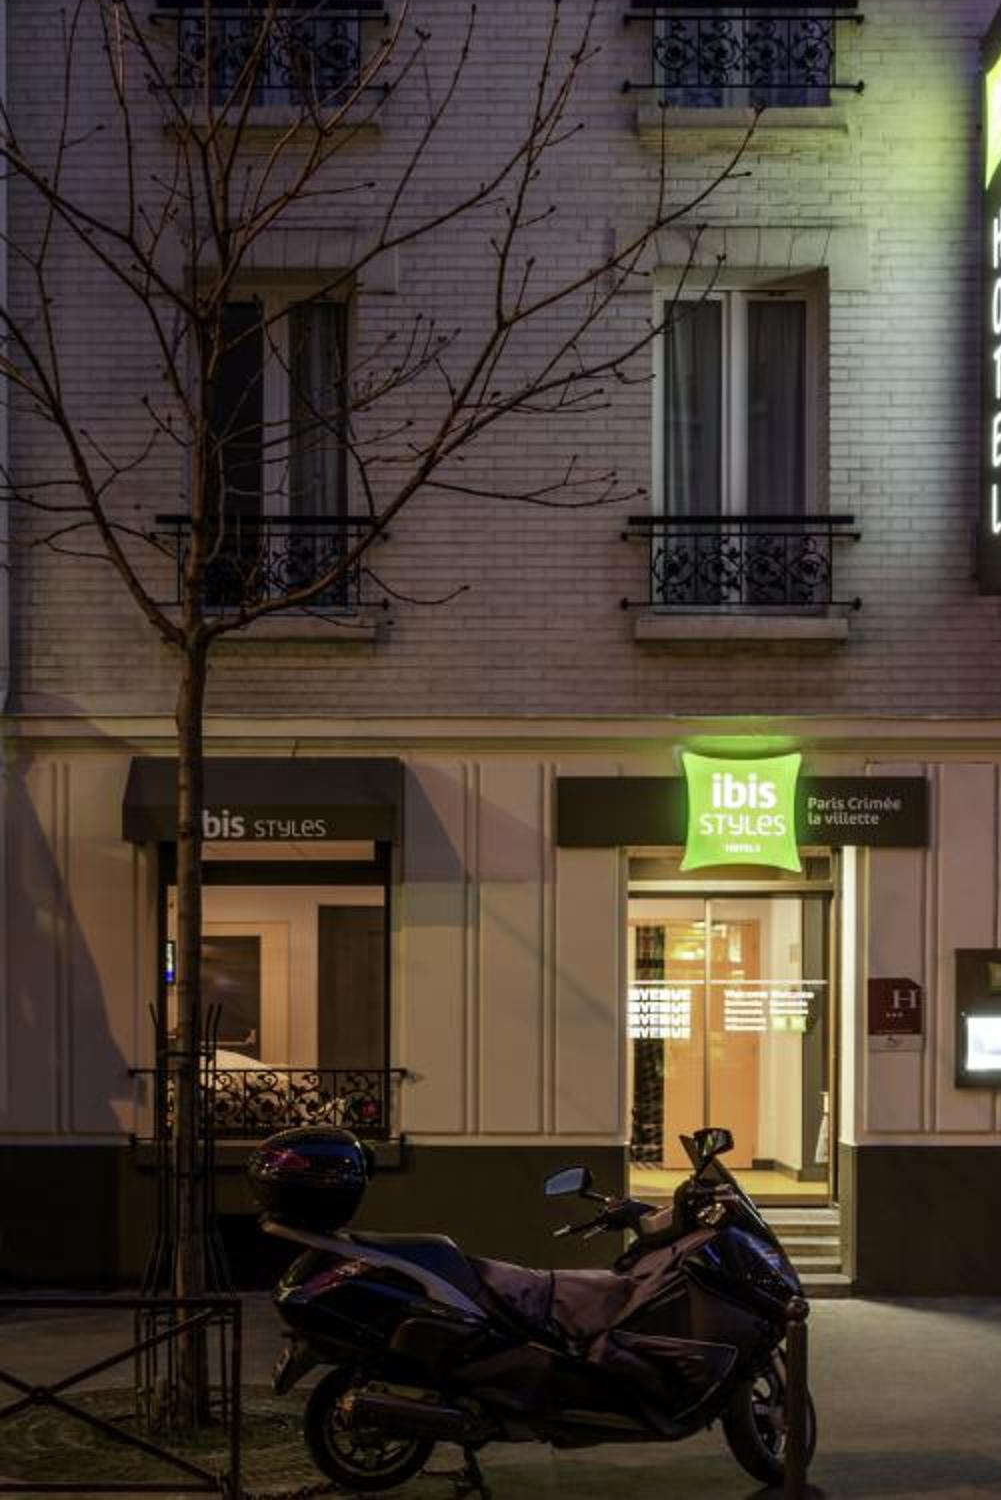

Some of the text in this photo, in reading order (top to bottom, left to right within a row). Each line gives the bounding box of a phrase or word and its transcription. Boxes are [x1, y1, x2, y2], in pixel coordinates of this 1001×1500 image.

[712, 772, 776, 808] ibis
[807, 797, 845, 810] Paris
[201, 809, 246, 838] bis
[893, 989, 917, 1009] H
